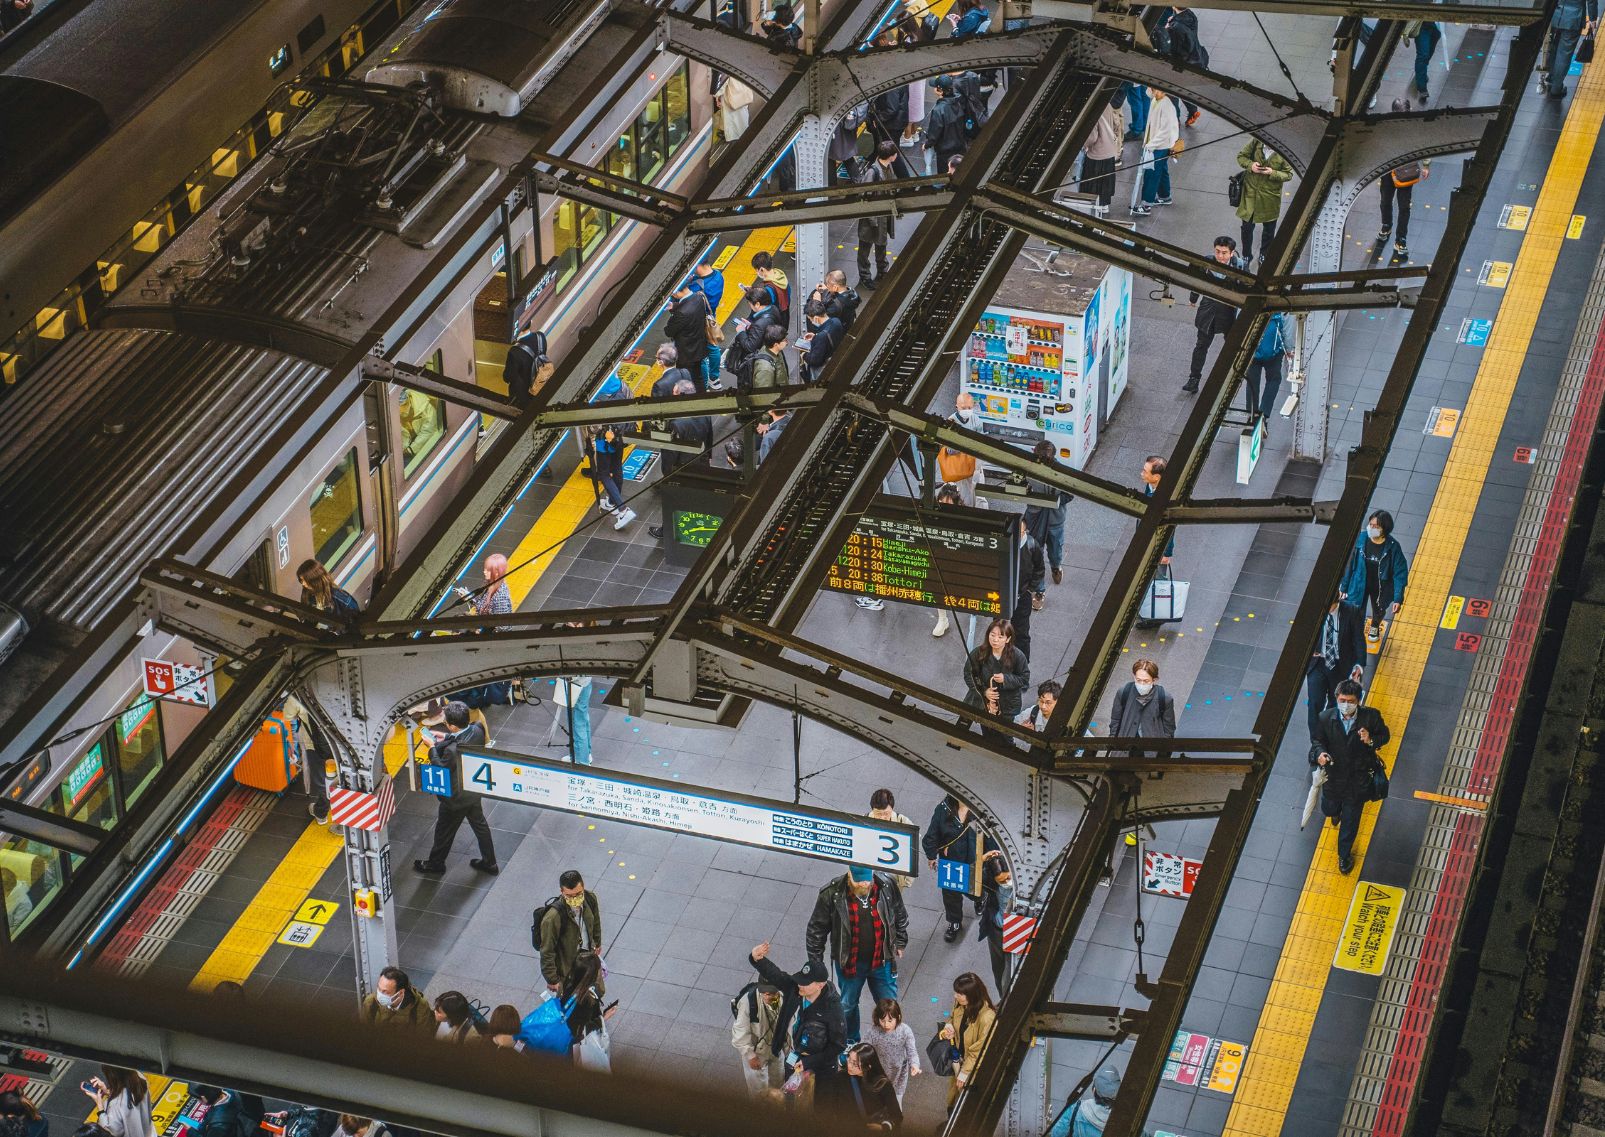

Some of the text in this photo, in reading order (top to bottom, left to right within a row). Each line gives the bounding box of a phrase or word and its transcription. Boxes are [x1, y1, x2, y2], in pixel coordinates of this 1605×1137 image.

[989, 537, 998, 549] 3
[848, 557, 883, 571] 20:30
[884, 574, 922, 588] Tottori
[148, 666, 170, 676] SOS
[424, 767, 445, 787] 11
[471, 763, 497, 791] 4
[816, 845, 851, 857] HAMAKAZE
[877, 835, 900, 865] 3
[942, 862, 963, 883] 11
[1156, 865, 1182, 875] ボタン
[1345, 903, 1374, 957] Watch your step
